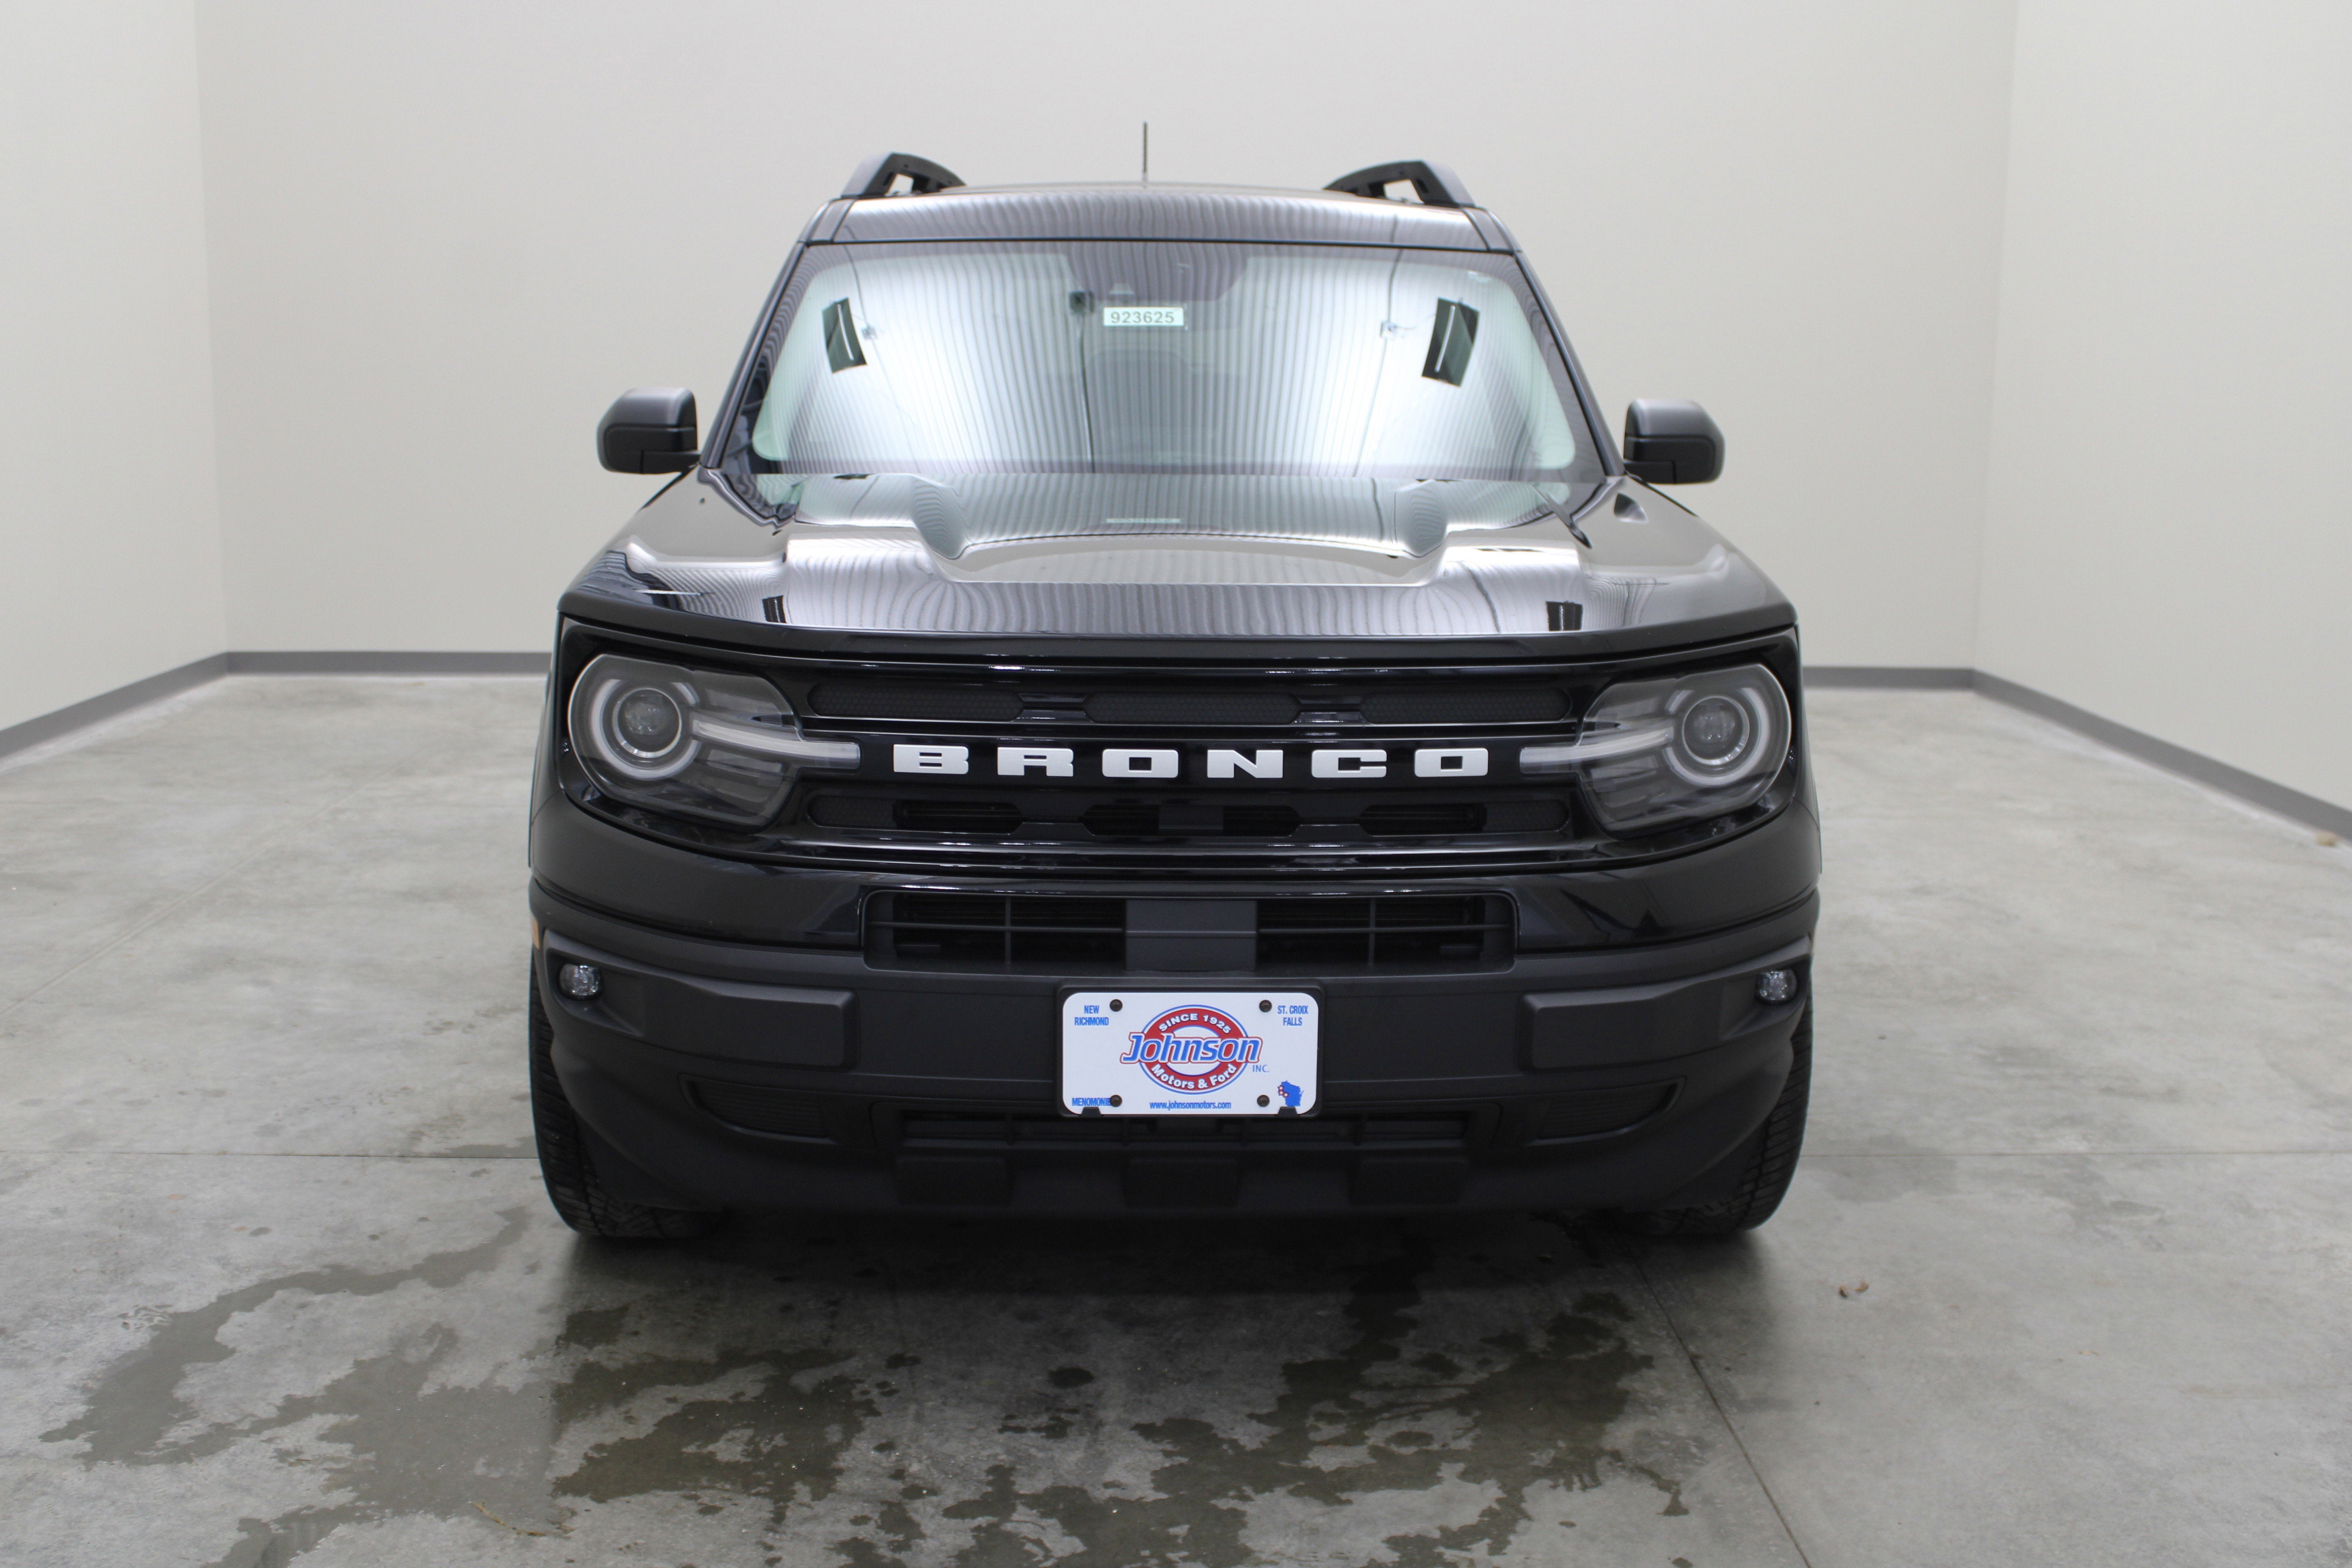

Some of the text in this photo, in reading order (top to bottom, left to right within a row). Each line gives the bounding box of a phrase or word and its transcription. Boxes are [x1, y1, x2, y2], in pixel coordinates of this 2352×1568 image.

[1111, 311, 1174, 324] 923625
[893, 744, 1488, 779] BRONCO
[1084, 1005, 1099, 1014] NEW
[1278, 1005, 1309, 1014] ST. CROIX
[1074, 1017, 1109, 1026] RICHMOND
[1158, 1013, 1232, 1034] SINCE 1925
[1283, 1017, 1303, 1026] FALLS
[1123, 1035, 1260, 1062] Johnson
[1252, 1065, 1270, 1073] INC.
[1151, 1063, 1237, 1089] Motors & Ford
[1149, 1100, 1232, 1111] www.johnsonmotors.com
